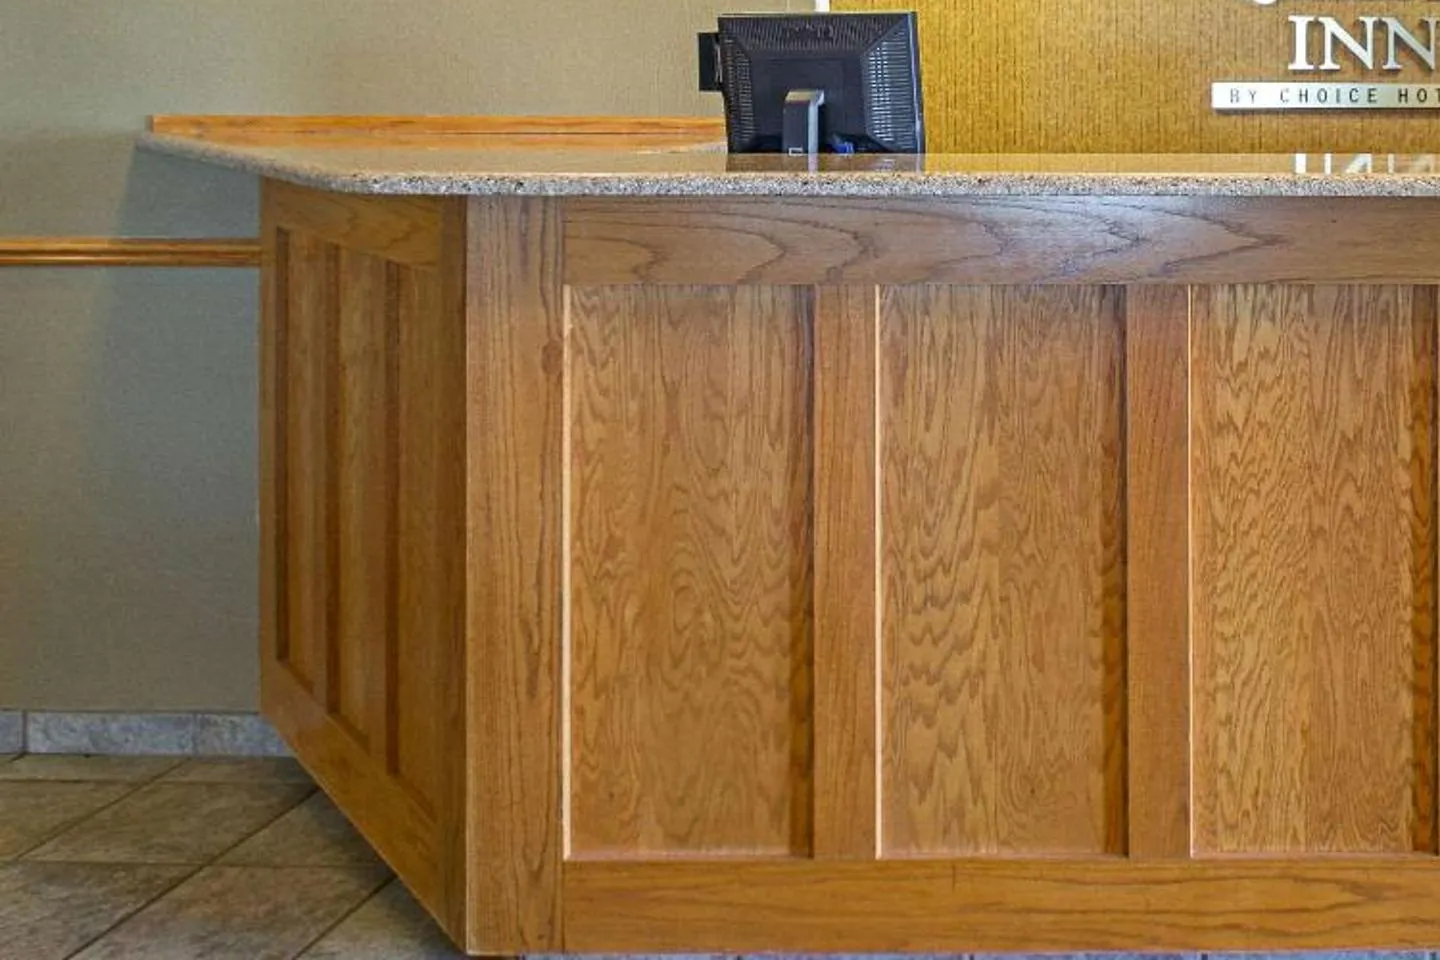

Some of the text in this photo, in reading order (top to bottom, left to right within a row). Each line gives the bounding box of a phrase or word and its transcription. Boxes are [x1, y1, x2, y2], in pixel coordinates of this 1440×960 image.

[1287, 14, 1440, 71] INN
[1229, 87, 1258, 104] BY
[1279, 87, 1379, 104] CHOICE
